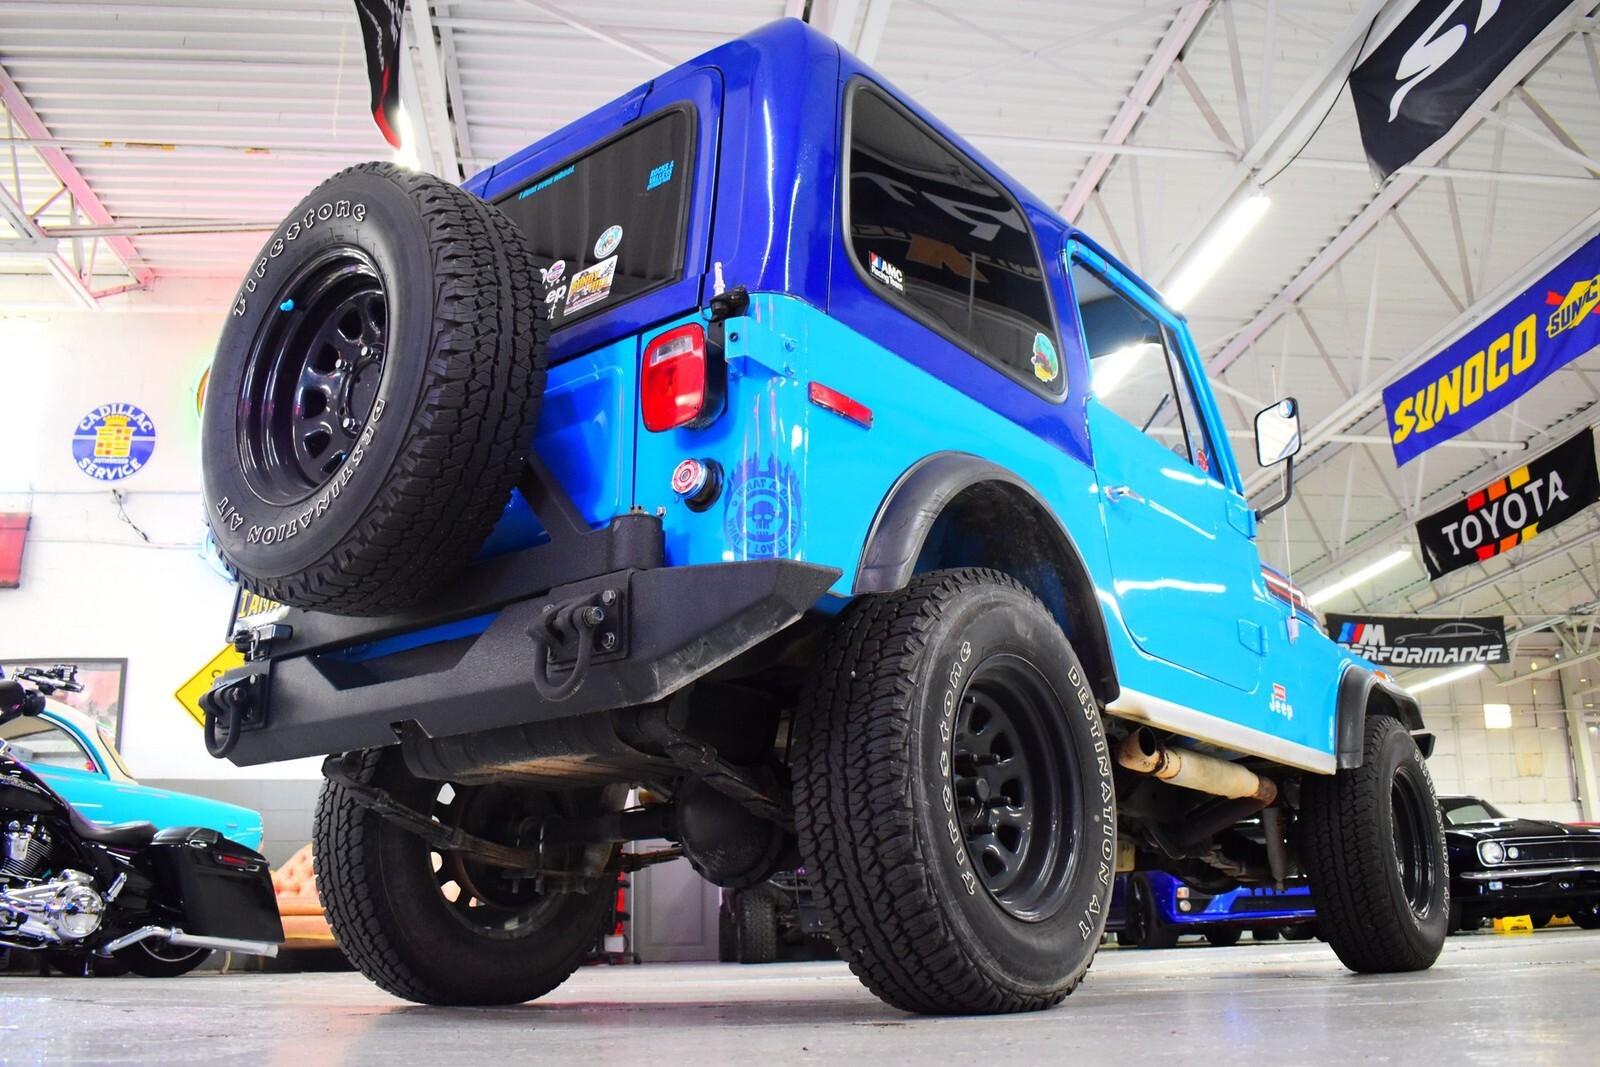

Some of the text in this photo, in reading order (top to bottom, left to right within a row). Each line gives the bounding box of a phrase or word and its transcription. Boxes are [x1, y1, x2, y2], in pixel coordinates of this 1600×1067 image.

[871, 264, 904, 291] Racing Team
[882, 260, 903, 283] AMC
[1393, 313, 1537, 445] SUNOCO
[79, 402, 153, 434] CADILLAC
[78, 456, 142, 480] SERVICE
[216, 398, 386, 545] DESTINATION A/T
[1441, 470, 1570, 556] TOYOTA
[1359, 624, 1387, 647] M
[1269, 693, 1293, 720] Jeep
[1067, 665, 1113, 940] DESTINATION A/T
